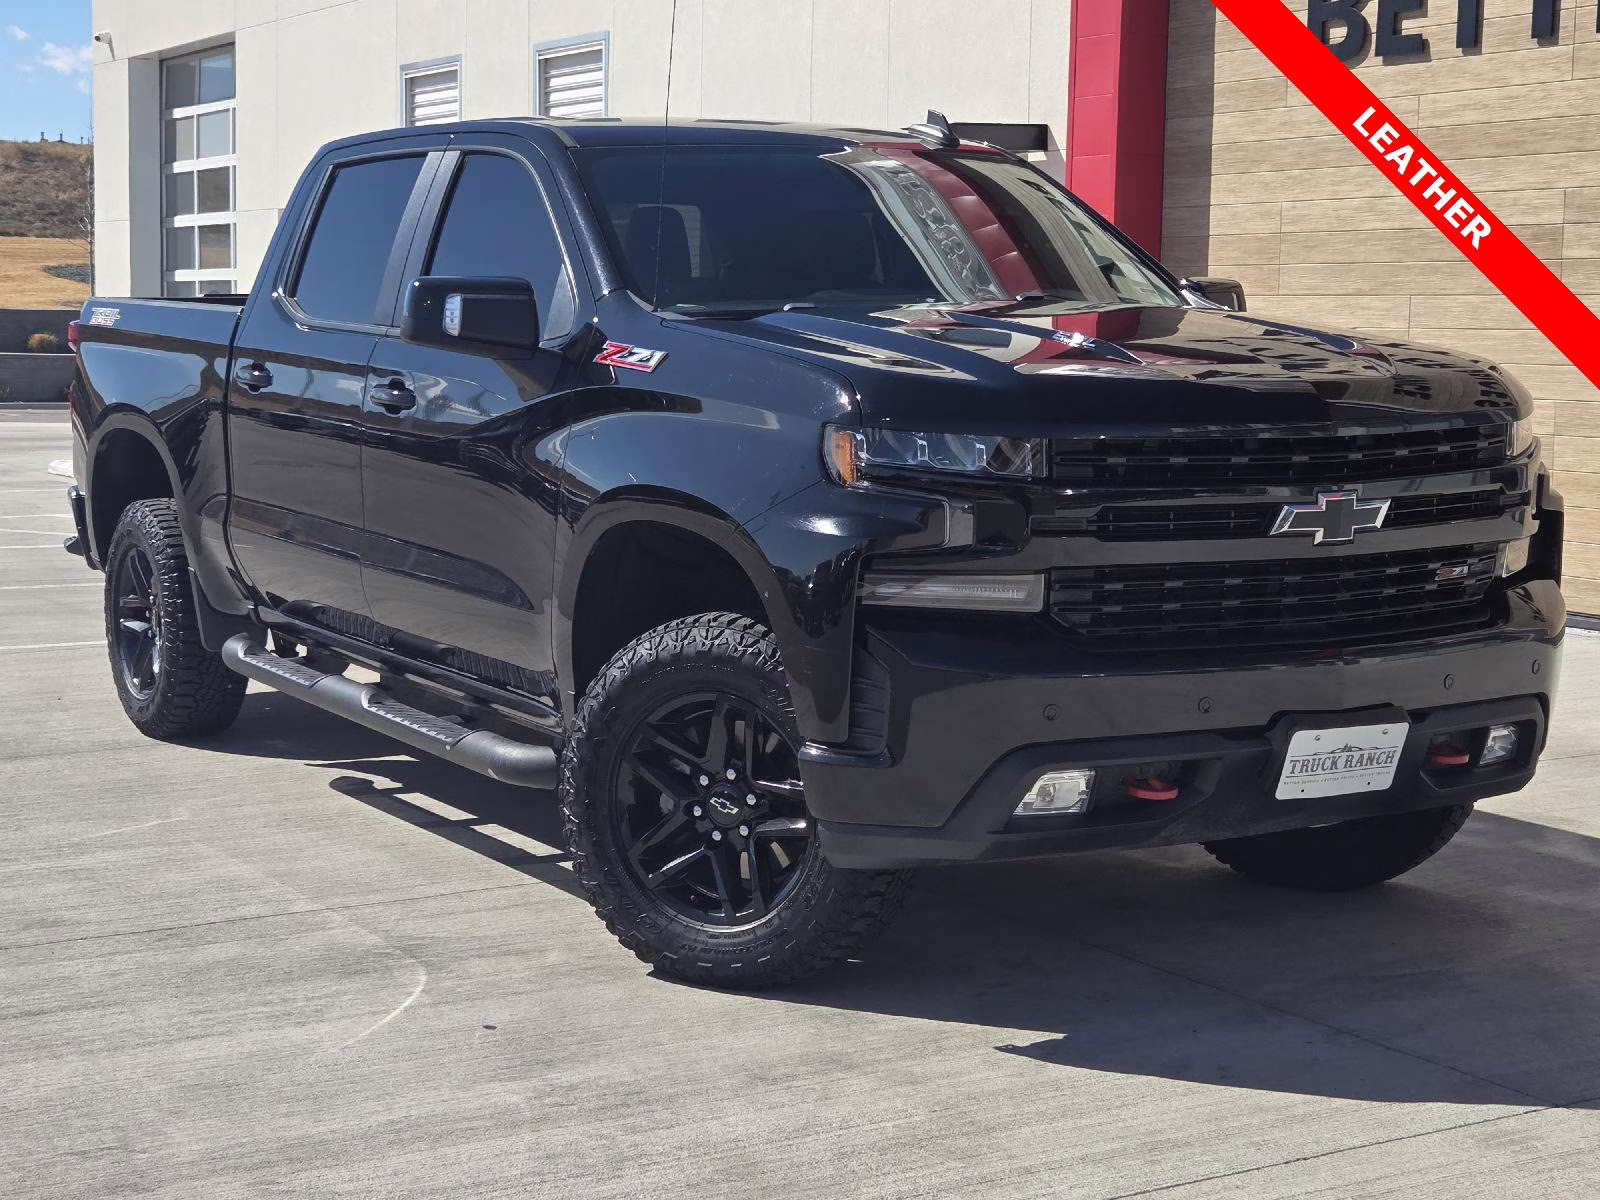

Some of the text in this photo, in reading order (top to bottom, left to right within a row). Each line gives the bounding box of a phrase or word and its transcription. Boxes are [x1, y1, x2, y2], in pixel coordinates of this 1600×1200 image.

[592, 340, 668, 373] Z71
[1289, 749, 1398, 775] TRUCK RANCH
